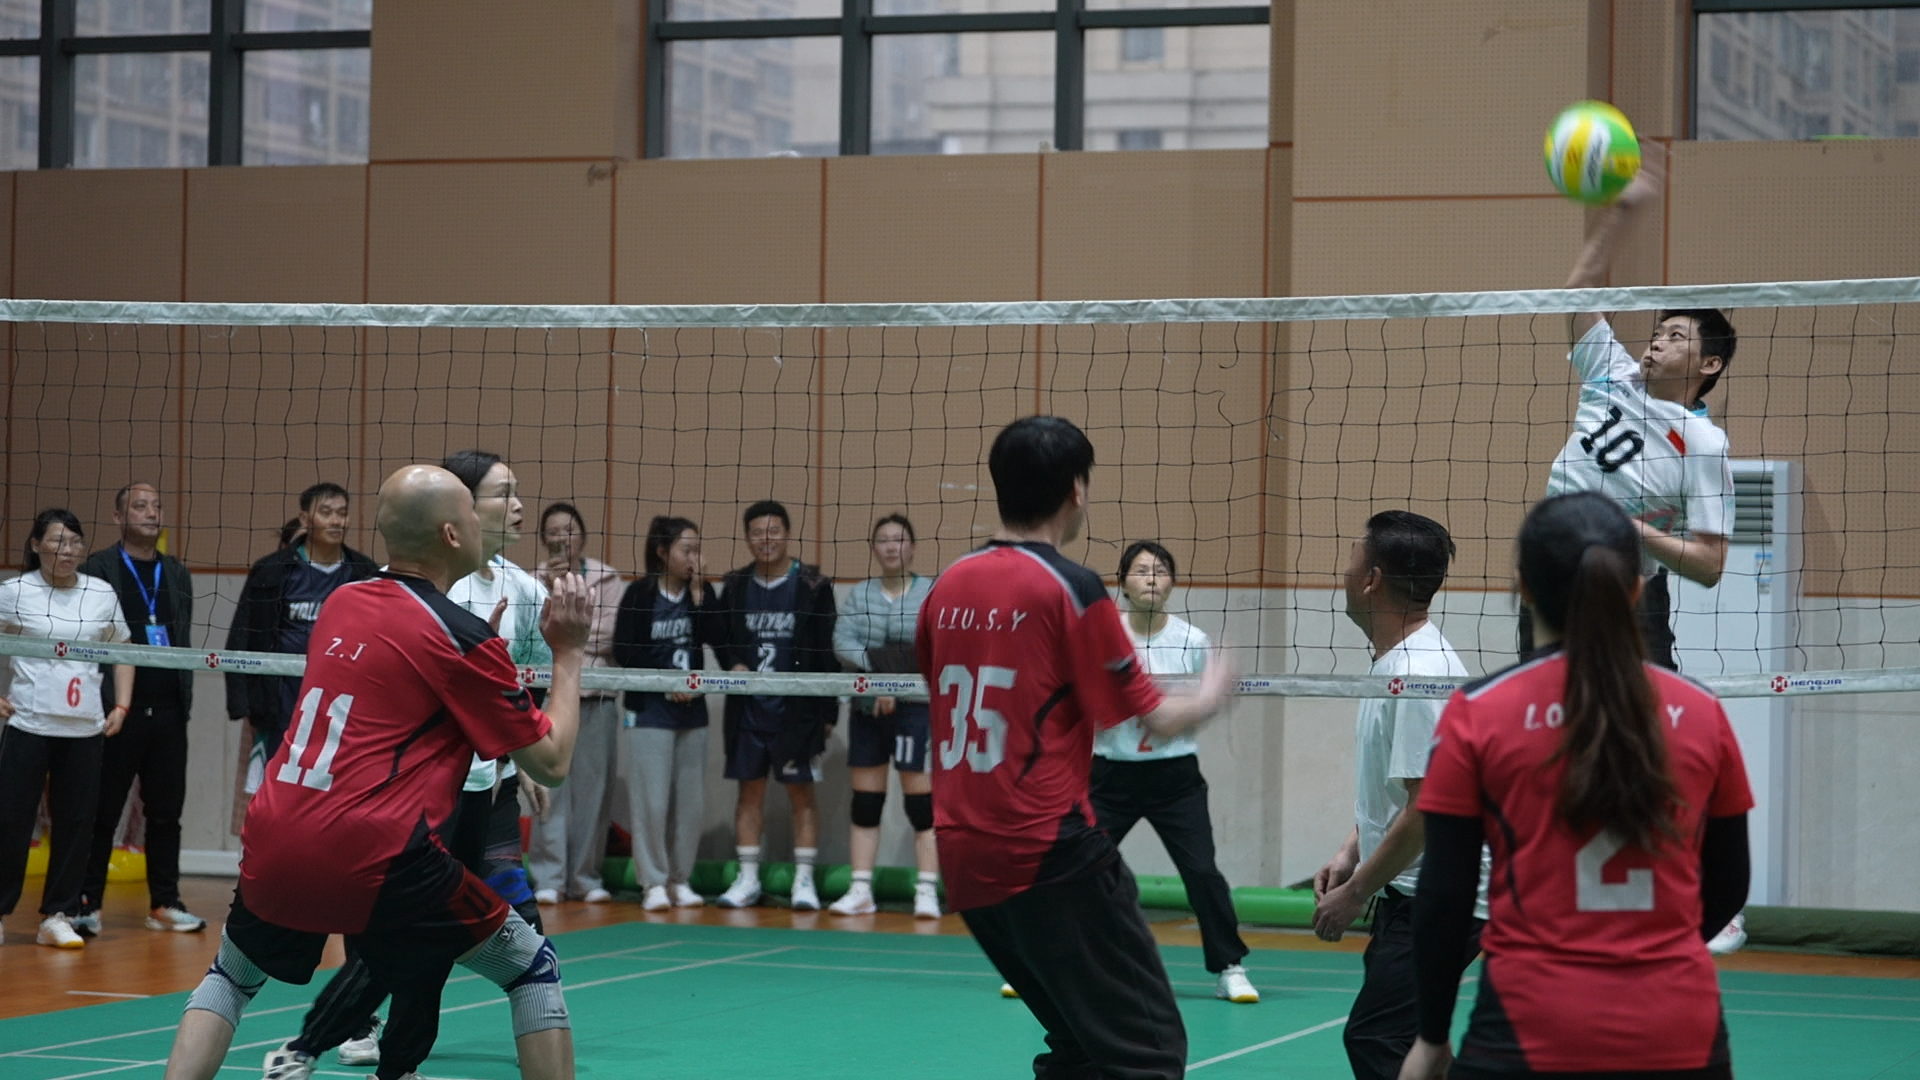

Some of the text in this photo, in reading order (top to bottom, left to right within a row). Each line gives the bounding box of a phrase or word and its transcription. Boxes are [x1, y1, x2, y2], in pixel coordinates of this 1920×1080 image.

[1580, 406, 1645, 473] 10
[937, 606, 1028, 632] LIU.S.Y
[69, 647, 109, 656] HENGJIA
[324, 637, 367, 661] Z.J
[672, 649, 690, 670] 9
[757, 643, 777, 671] 2
[221, 658, 262, 667] HENGJIA
[66, 677, 82, 707] 6
[703, 678, 748, 686] HENGJIA
[1406, 683, 1456, 691] HENGJIA
[1790, 678, 1842, 686] HENGJIA
[938, 664, 1018, 773] 35
[276, 687, 355, 792] 11
[895, 735, 915, 763] 11
[1575, 826, 1656, 911] 2
